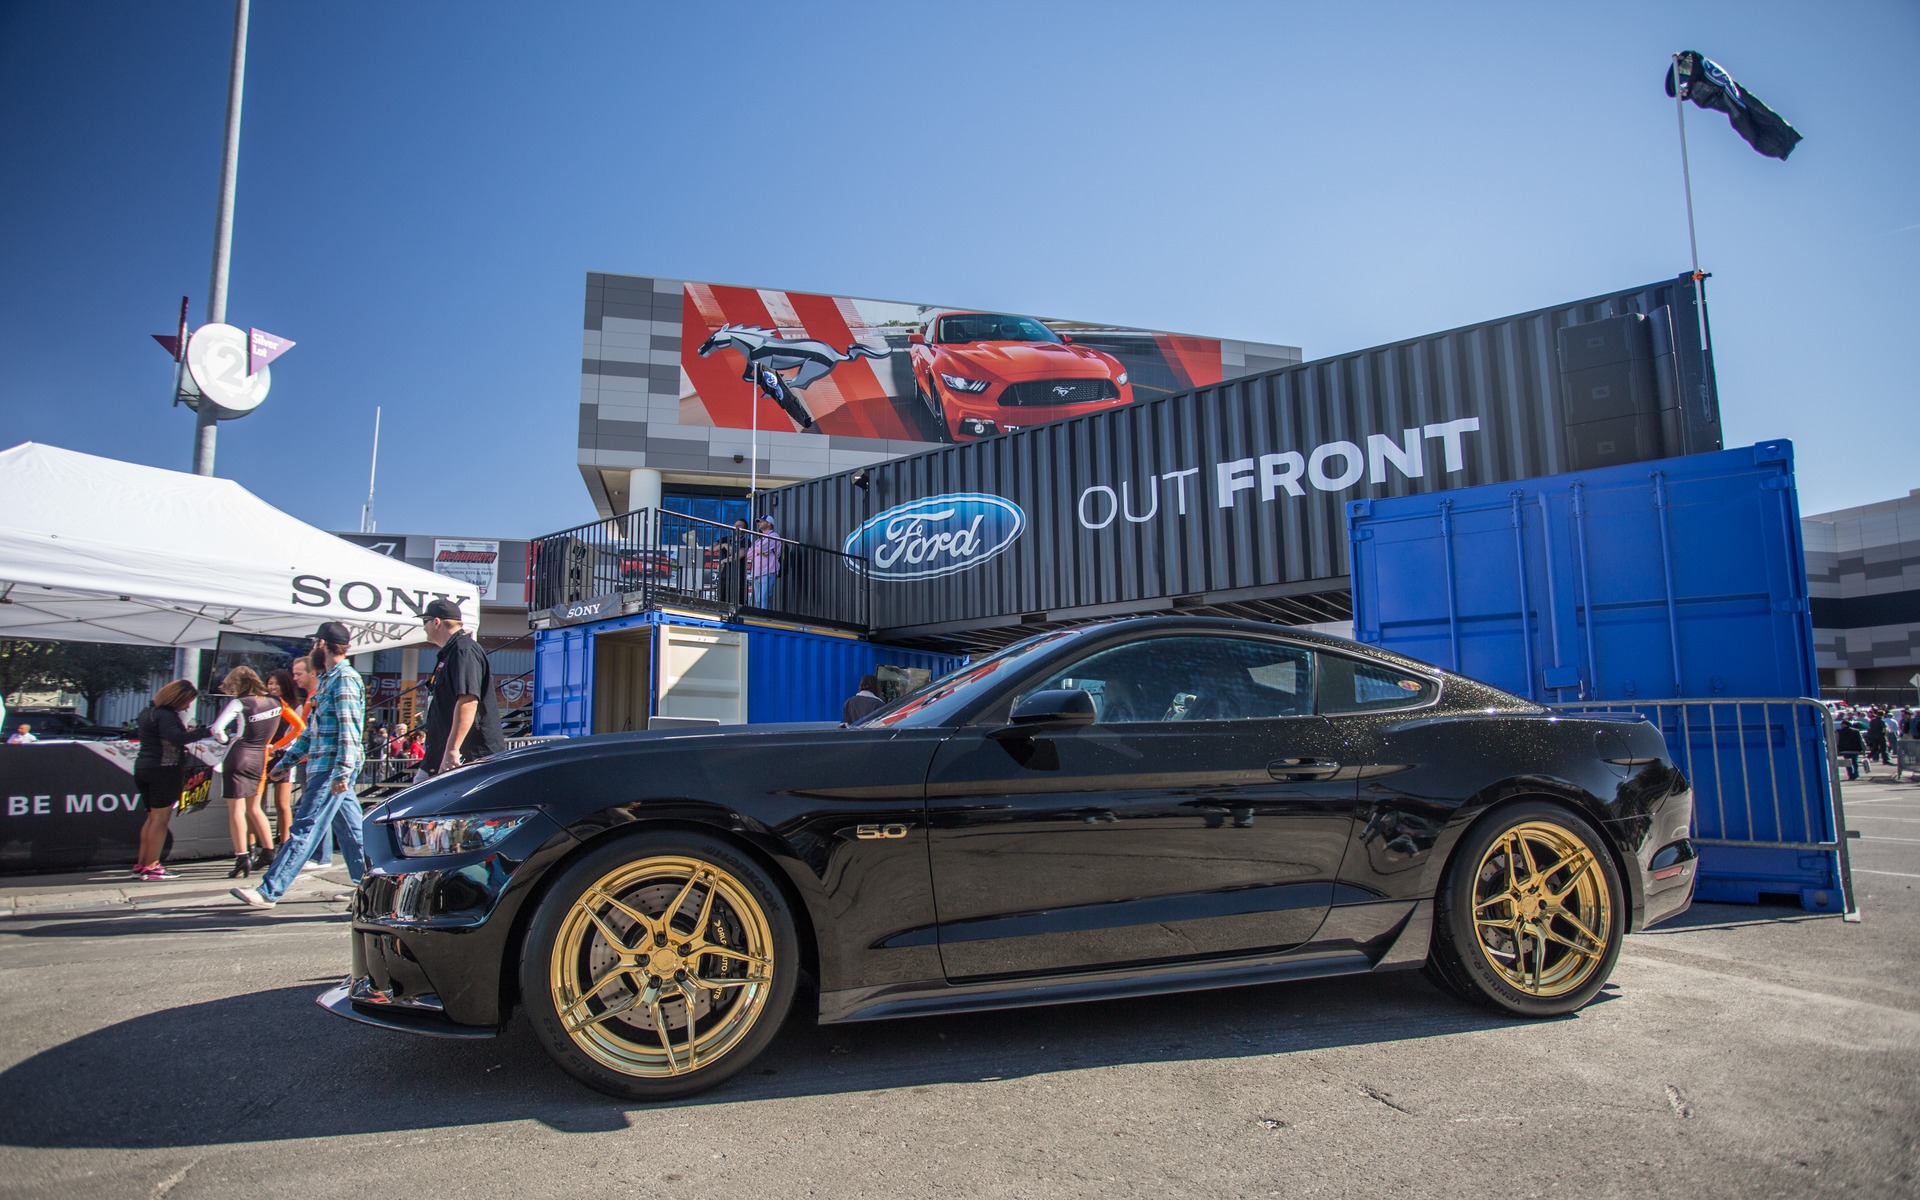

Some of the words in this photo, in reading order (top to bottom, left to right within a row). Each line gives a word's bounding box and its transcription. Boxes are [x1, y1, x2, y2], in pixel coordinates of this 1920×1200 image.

[252, 333, 279, 350] Silver
[252, 344, 268, 357] Lot
[217, 345, 244, 388] 2
[1078, 467, 1199, 530] OUT
[1216, 416, 1480, 509] FRONT
[875, 508, 984, 569] Ford
[566, 603, 601, 618] SONY
[8, 795, 51, 816] BE
[65, 793, 142, 813] MOV
[856, 823, 908, 839] 5.0
